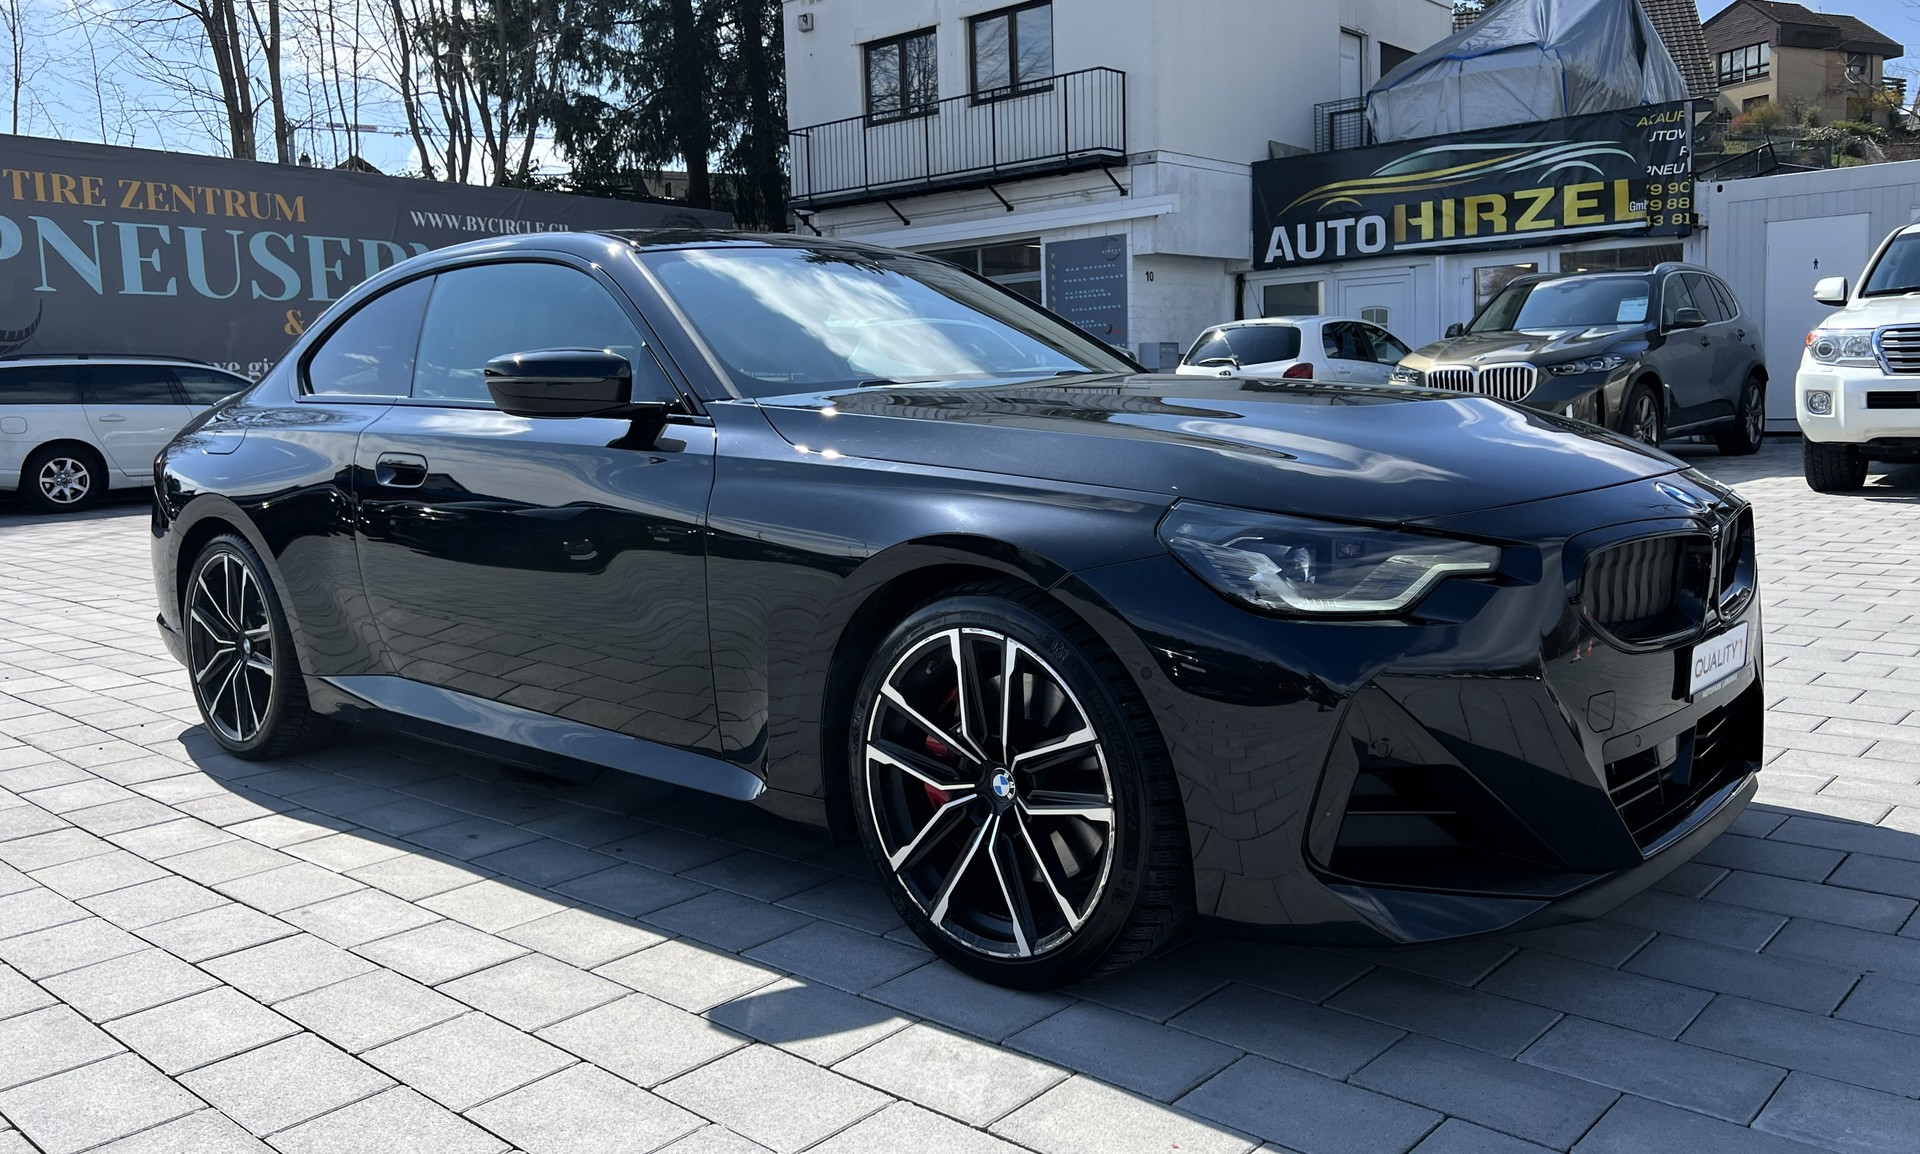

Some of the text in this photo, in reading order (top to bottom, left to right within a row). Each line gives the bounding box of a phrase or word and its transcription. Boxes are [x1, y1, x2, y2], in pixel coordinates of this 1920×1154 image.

[2, 168, 307, 223] TIRE ZENTRUM
[1666, 197, 1690, 209] 88
[1264, 215, 1386, 263] AUTO
[1393, 178, 1647, 242] HIRZEL
[1671, 212, 1690, 225] 81
[1145, 270, 1155, 282] 10
[284, 309, 304, 335] &
